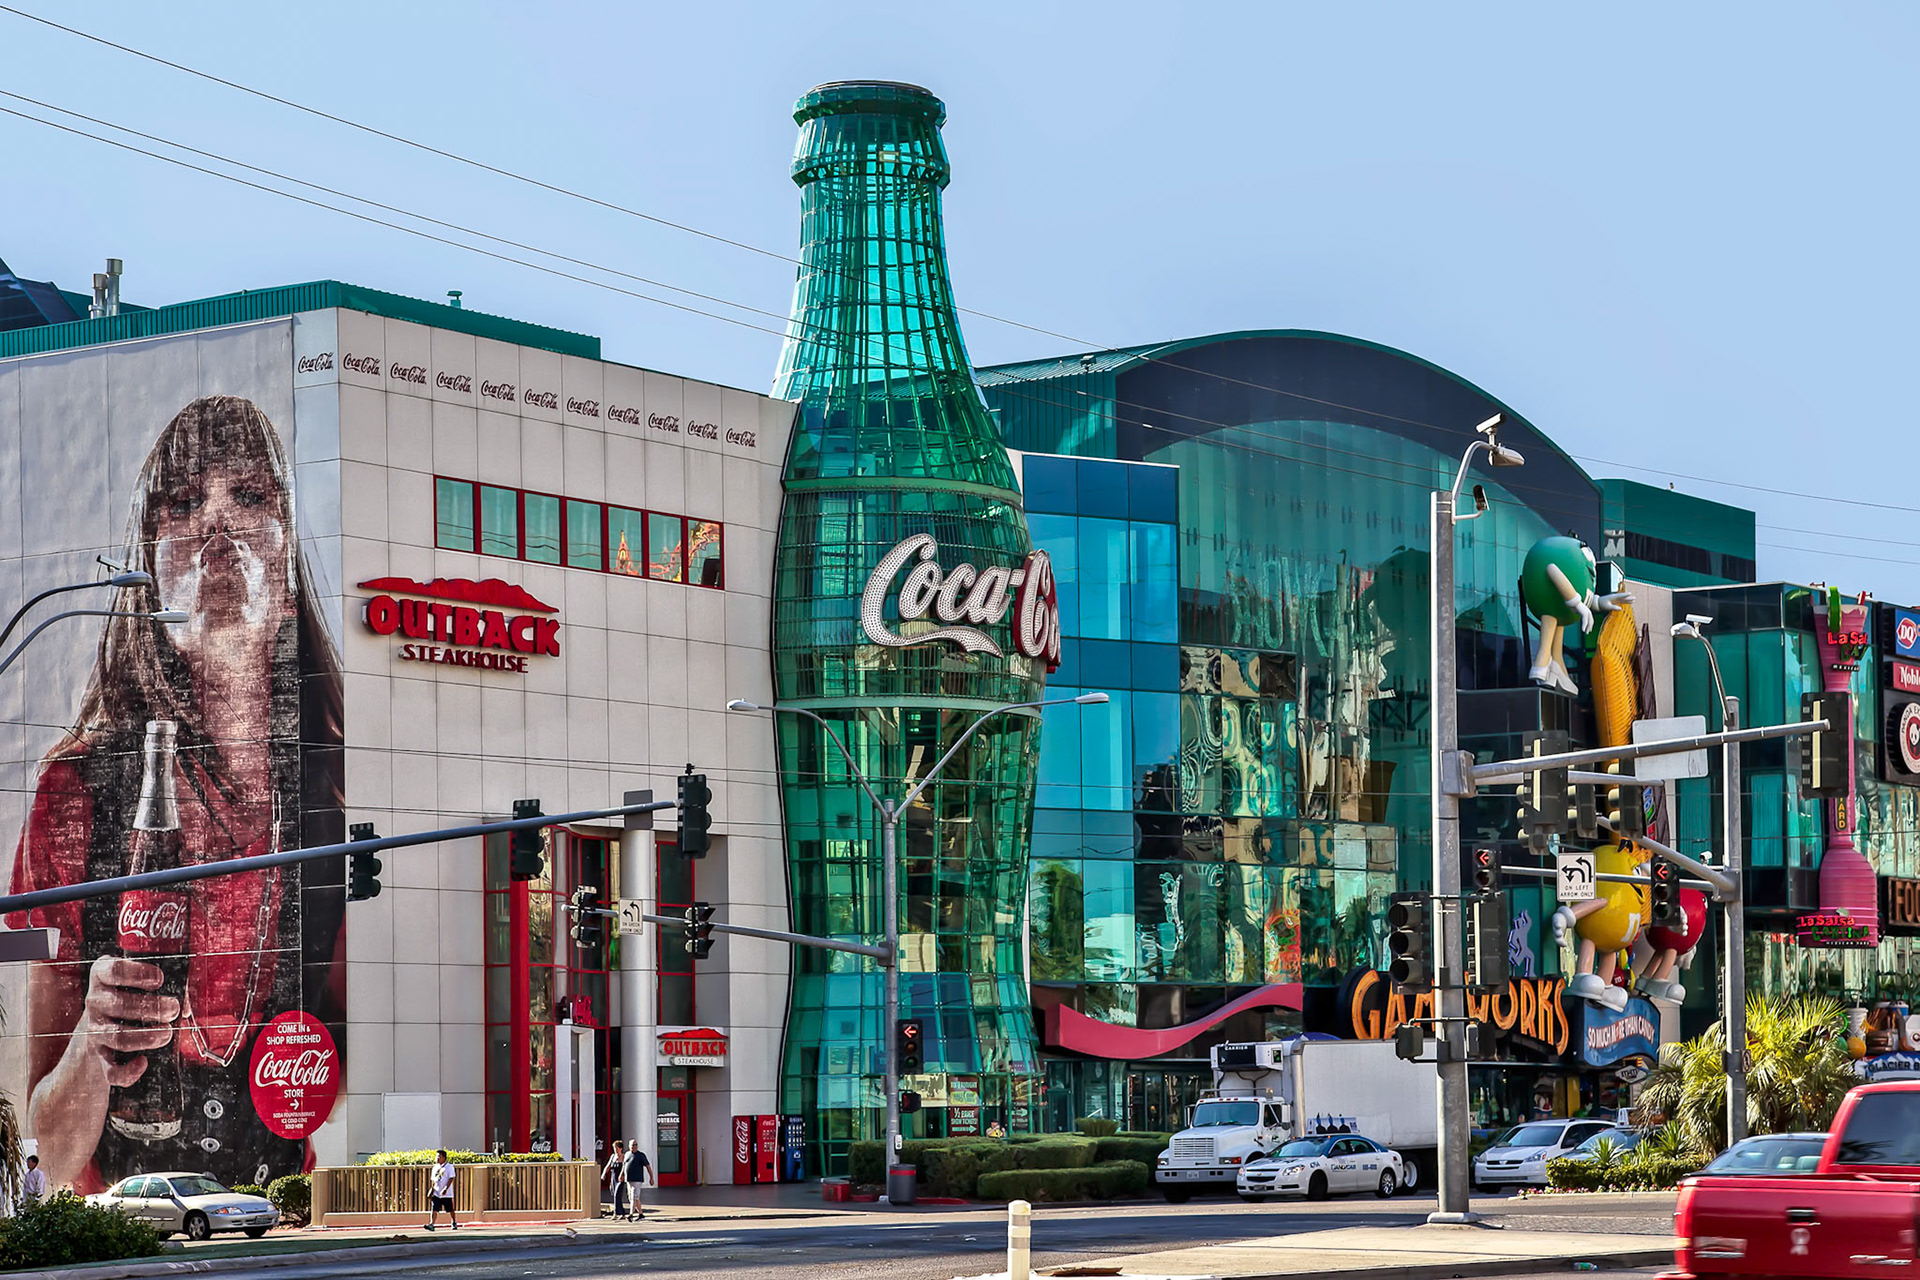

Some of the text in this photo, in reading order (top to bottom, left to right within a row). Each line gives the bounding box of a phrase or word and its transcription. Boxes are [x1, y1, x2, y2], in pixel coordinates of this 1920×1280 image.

[367, 594, 560, 657] OUTBACK
[1901, 624, 1914, 642] DQ
[402, 644, 528, 673] STEAKHOUSE
[1900, 666, 1920, 688] Nobl
[1811, 926, 1869, 941] CANTINA
[1352, 969, 1569, 1056] GAMWORKS
[277, 1024, 297, 1034] COME
[298, 1024, 306, 1032] IN
[1588, 1027, 1596, 1048] SO
[1596, 1026, 1610, 1049] MUCH
[1625, 1015, 1638, 1037] THAN
[1639, 1015, 1655, 1044] CANDY
[266, 1034, 321, 1045] SHOP REFRESHED
[663, 1040, 727, 1056] OUTBACK
[1867, 1060, 1911, 1072] GLACIER
[284, 1089, 304, 1098] STORE
